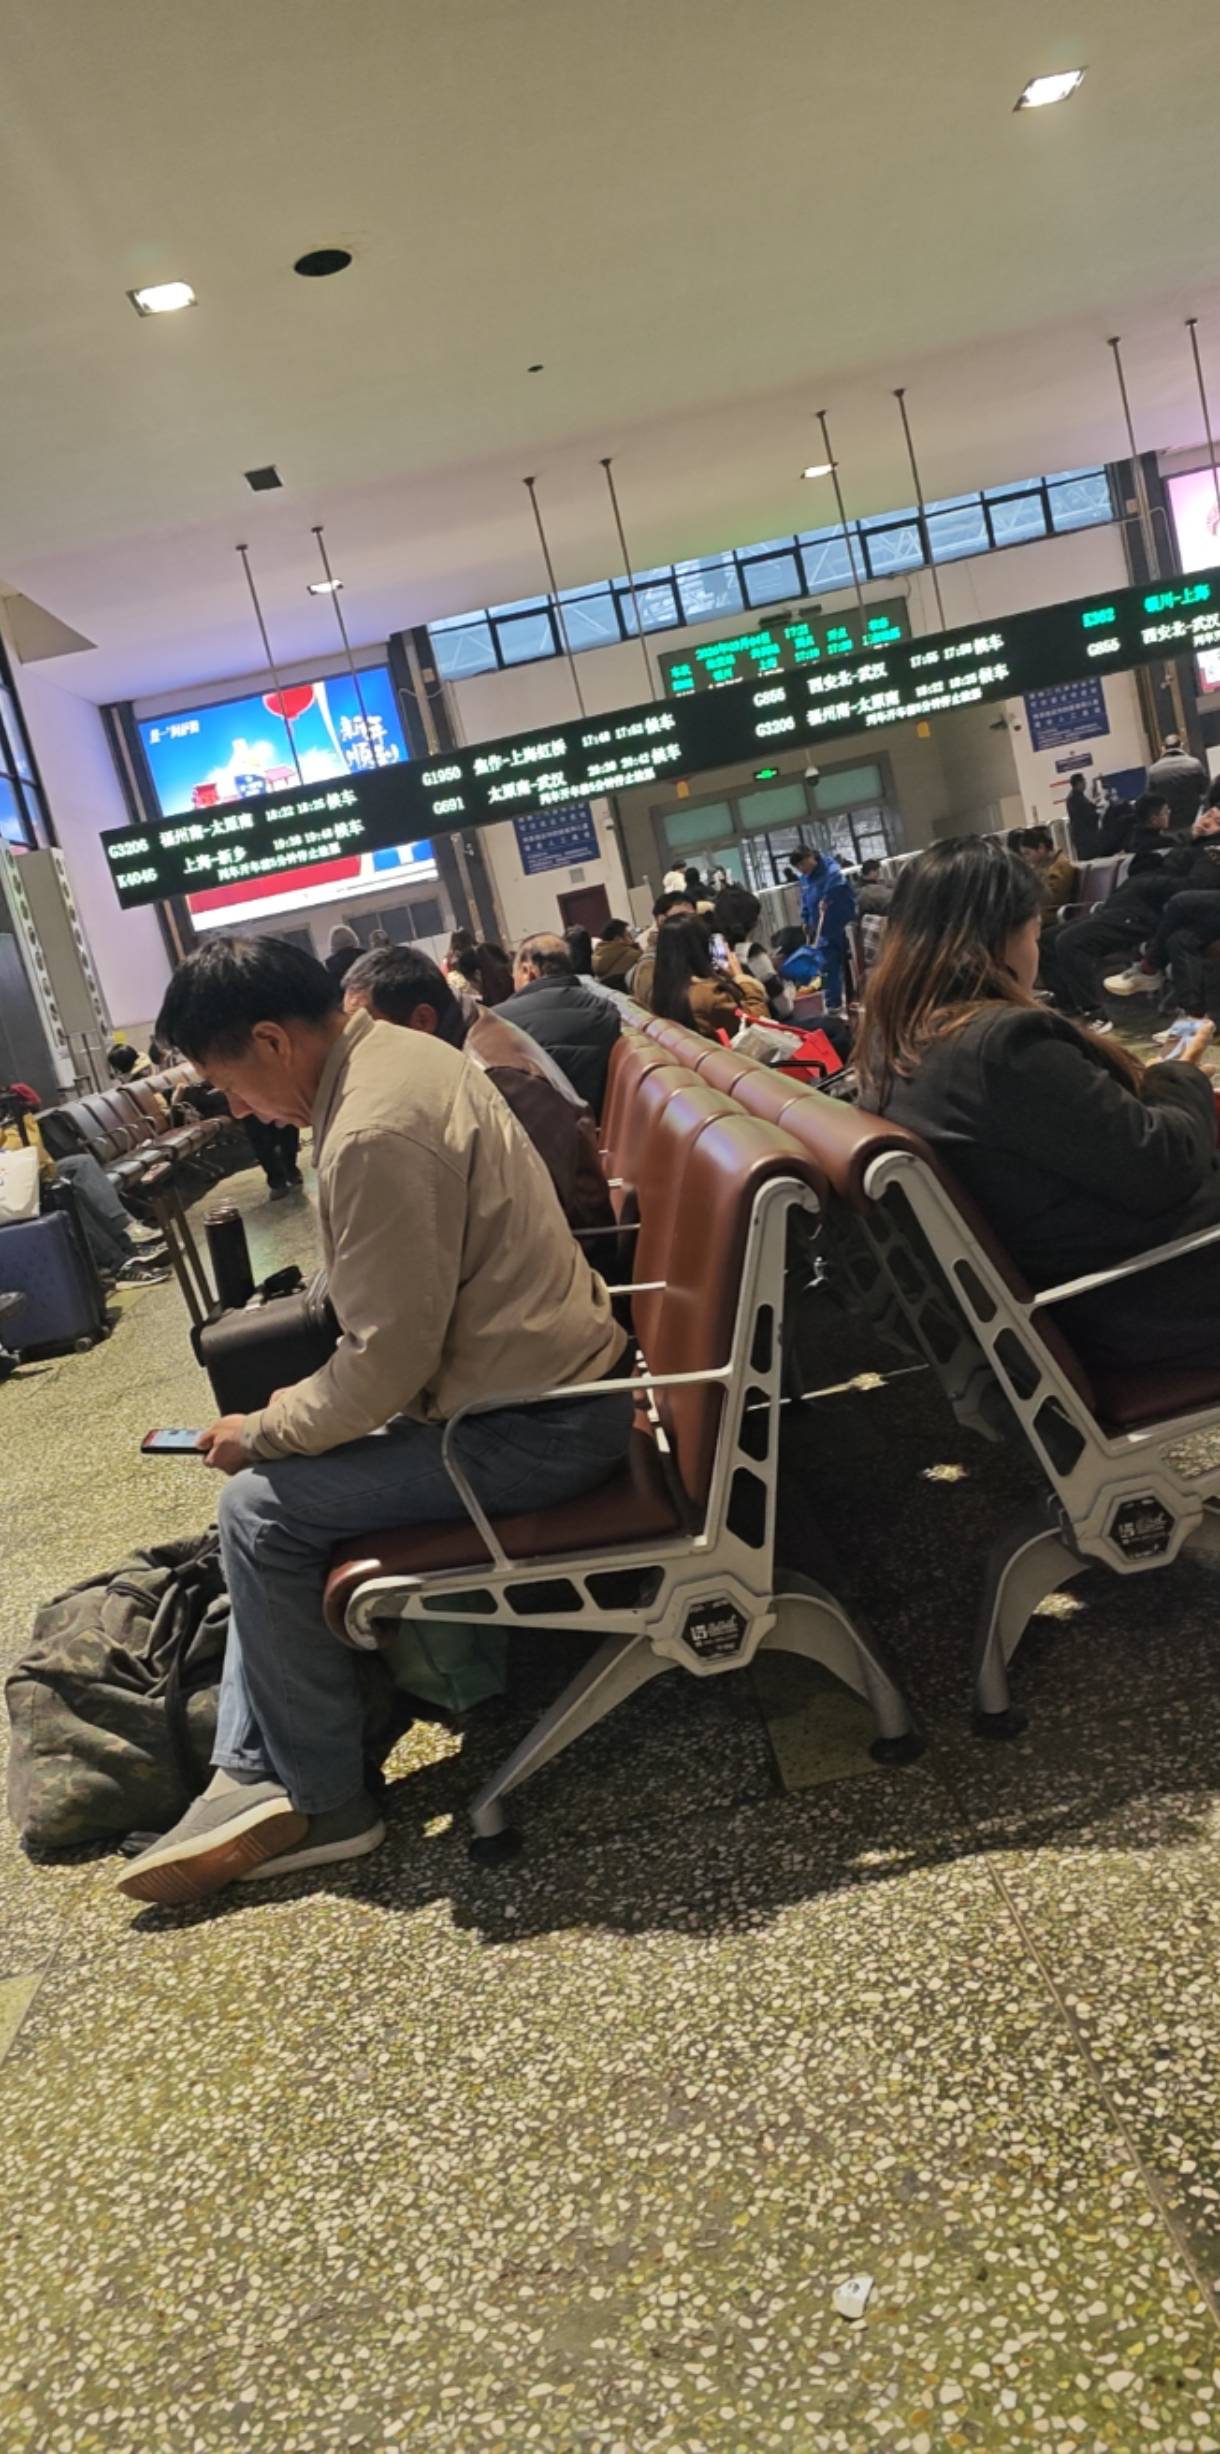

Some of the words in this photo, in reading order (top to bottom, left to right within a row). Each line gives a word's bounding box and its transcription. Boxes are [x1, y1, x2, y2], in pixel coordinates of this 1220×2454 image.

[806, 662, 889, 695] 西安北-武汉
[422, 766, 462, 787] G1950
[473, 738, 567, 776] 焦作-上海虹桥
[488, 771, 567, 804] 太原南-武汉
[108, 838, 149, 860] G3206
[184, 846, 247, 874] 上海-新乡
